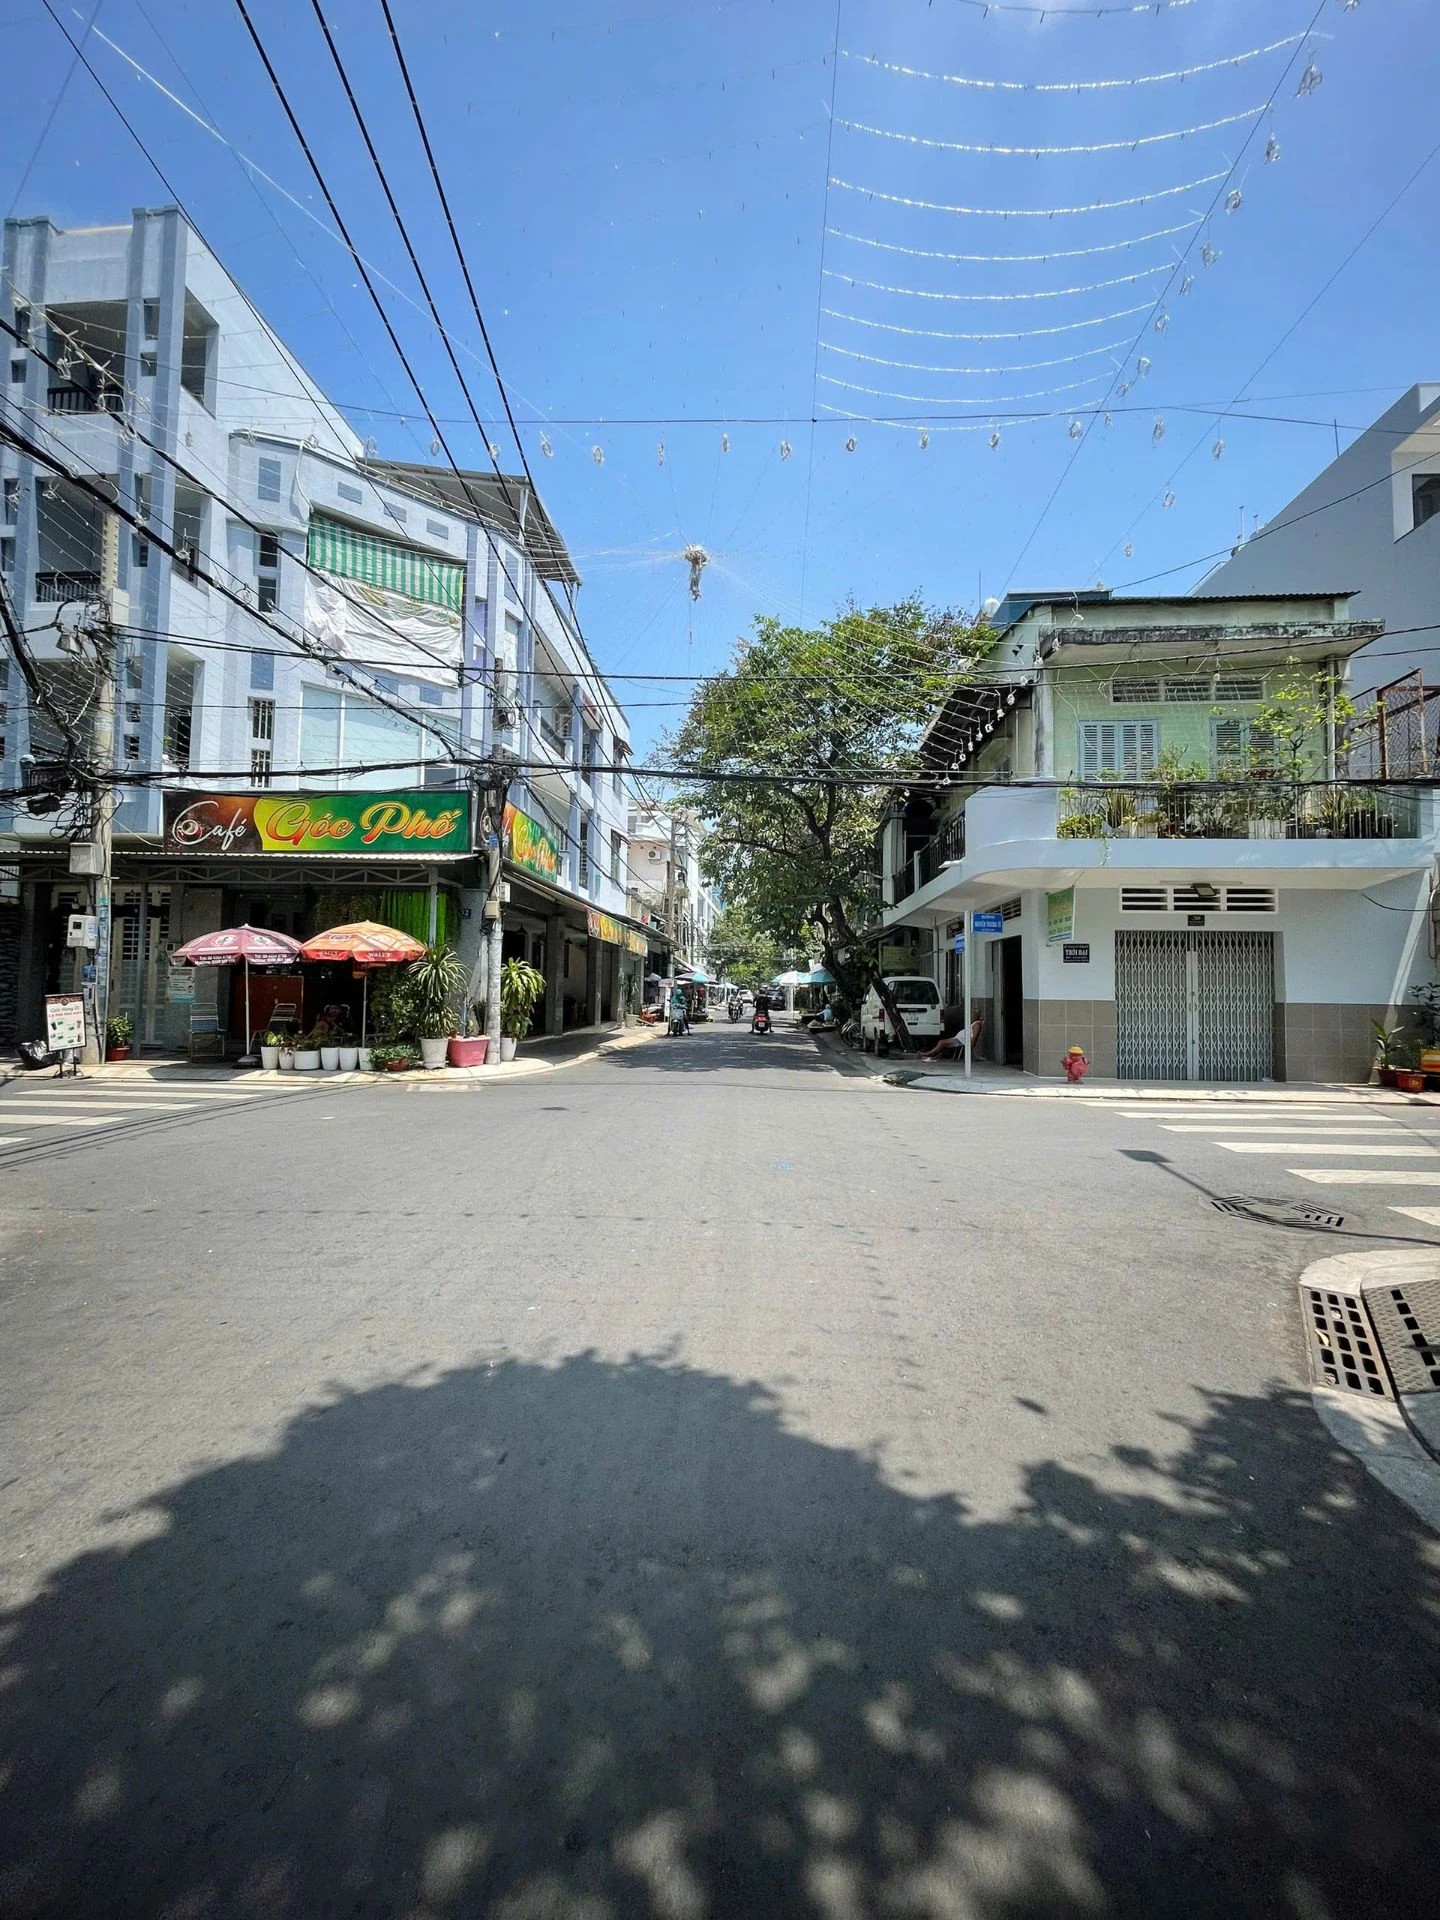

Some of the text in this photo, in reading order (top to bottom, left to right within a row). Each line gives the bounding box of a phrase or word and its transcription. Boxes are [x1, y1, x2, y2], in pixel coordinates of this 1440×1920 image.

[172, 800, 463, 850] Café Góc Phố
